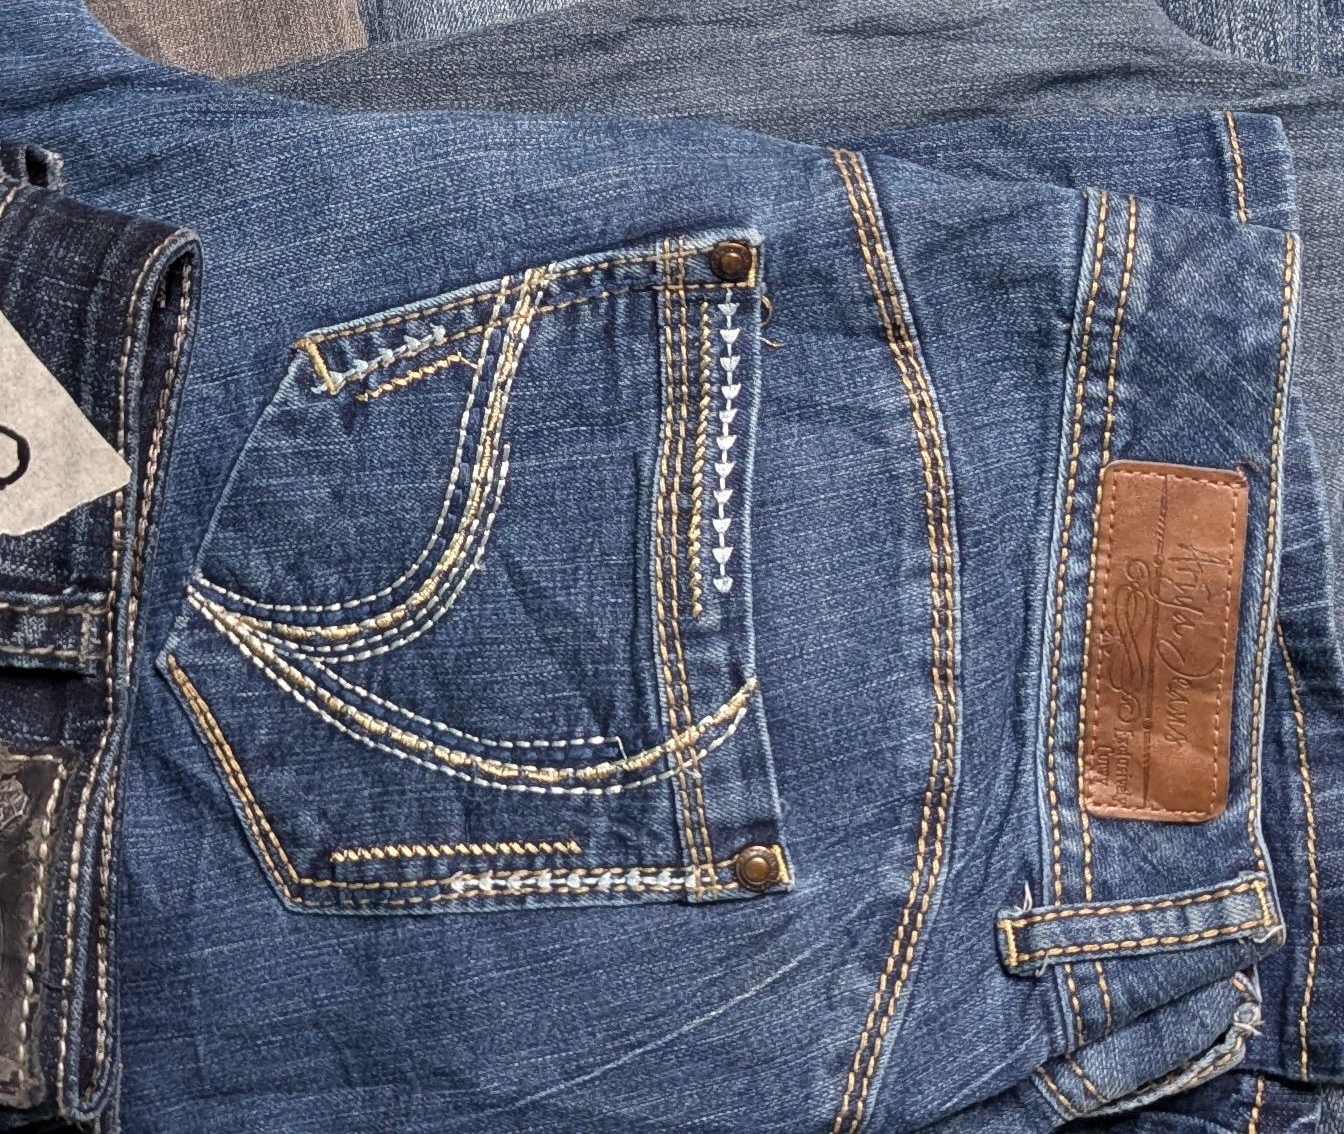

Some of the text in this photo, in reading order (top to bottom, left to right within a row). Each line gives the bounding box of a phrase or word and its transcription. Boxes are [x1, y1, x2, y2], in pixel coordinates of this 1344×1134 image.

[1150, 543, 1226, 748] Ariya Jeans
[1112, 728, 1134, 807] Exclusively
